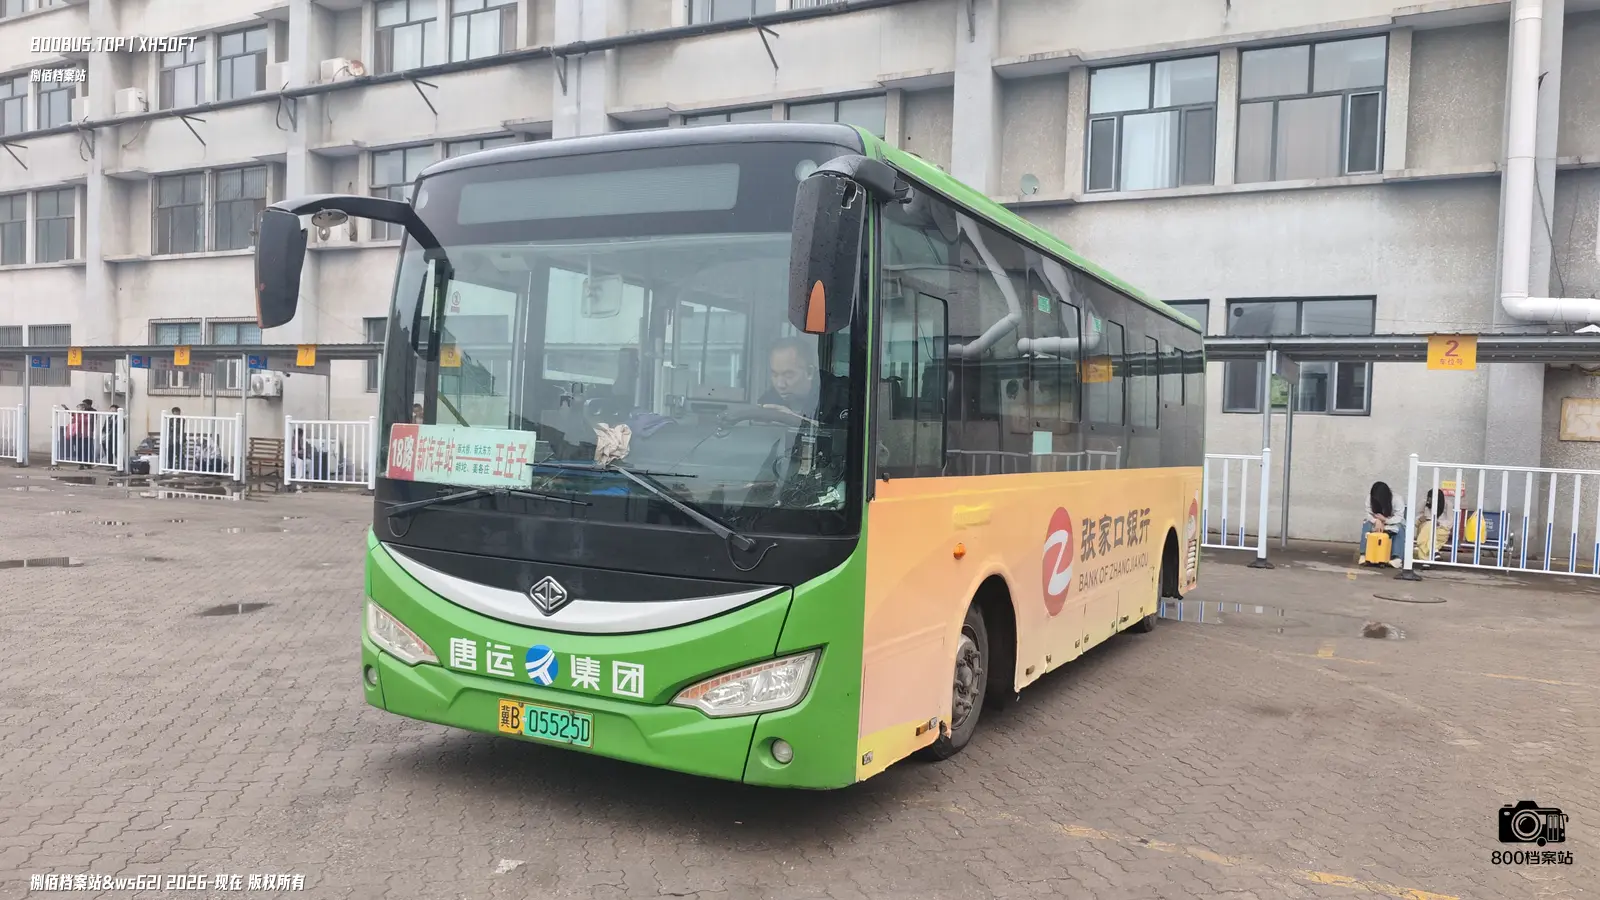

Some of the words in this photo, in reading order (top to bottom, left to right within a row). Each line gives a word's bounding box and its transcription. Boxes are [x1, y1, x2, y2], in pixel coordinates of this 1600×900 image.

[72, 349, 77, 359] 9
[180, 347, 185, 358] 8
[303, 347, 309, 358] 7
[1439, 358, 1463, 366] 车位号
[1445, 340, 1459, 357] 2
[391, 435, 414, 472] 18路
[416, 436, 456, 476] 新汽车站
[493, 441, 528, 480] 王庄子
[1080, 508, 1150, 563] 张家口银行
[1079, 569, 1098, 592] BANK
[1099, 565, 1109, 584] OF
[1110, 552, 1149, 580] ZHANGJIAKOU
[450, 637, 515, 677] 唐运
[570, 654, 645, 698] 集团
